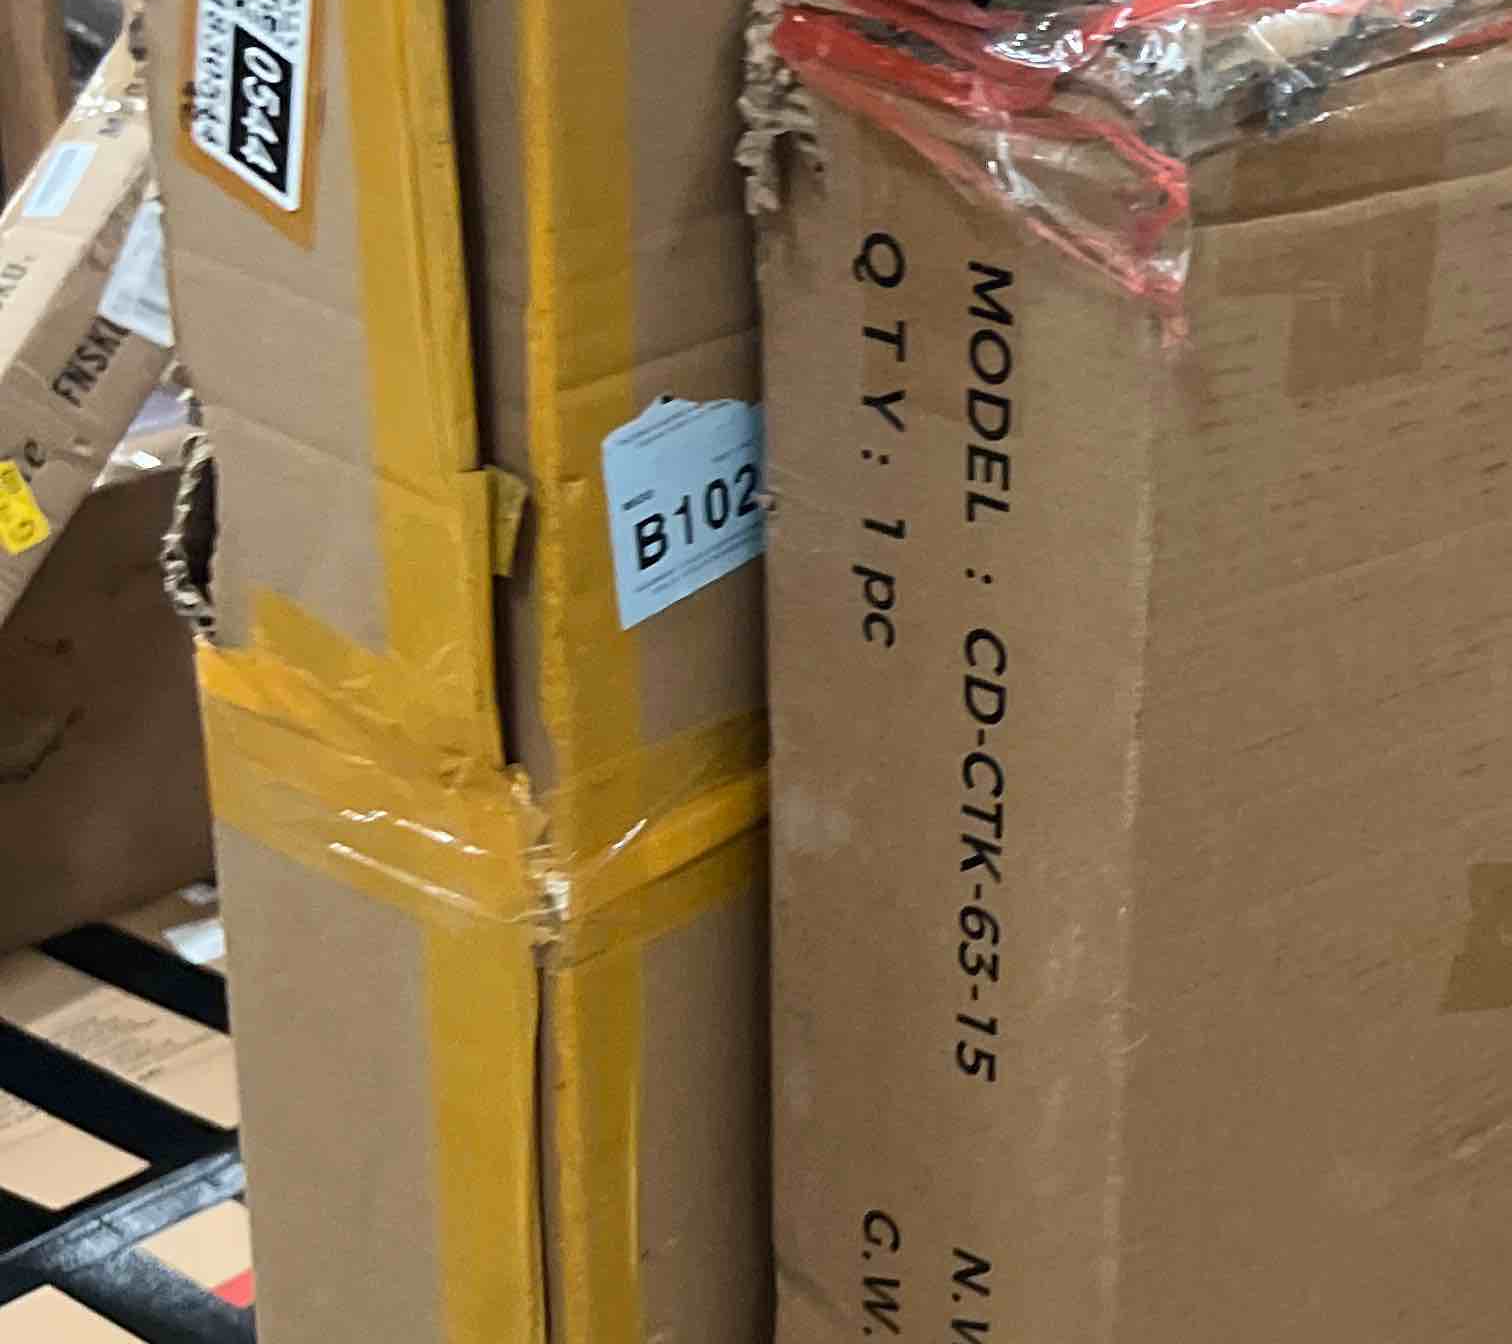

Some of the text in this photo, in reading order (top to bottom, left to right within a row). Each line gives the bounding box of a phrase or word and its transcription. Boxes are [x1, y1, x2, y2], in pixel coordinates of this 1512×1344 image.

[241, 46, 284, 174] 0544
[634, 462, 760, 571] B102
[862, 516, 907, 541] 1
[852, 563, 897, 649] pc
[955, 628, 1008, 1084] CD-CTK-63-15
